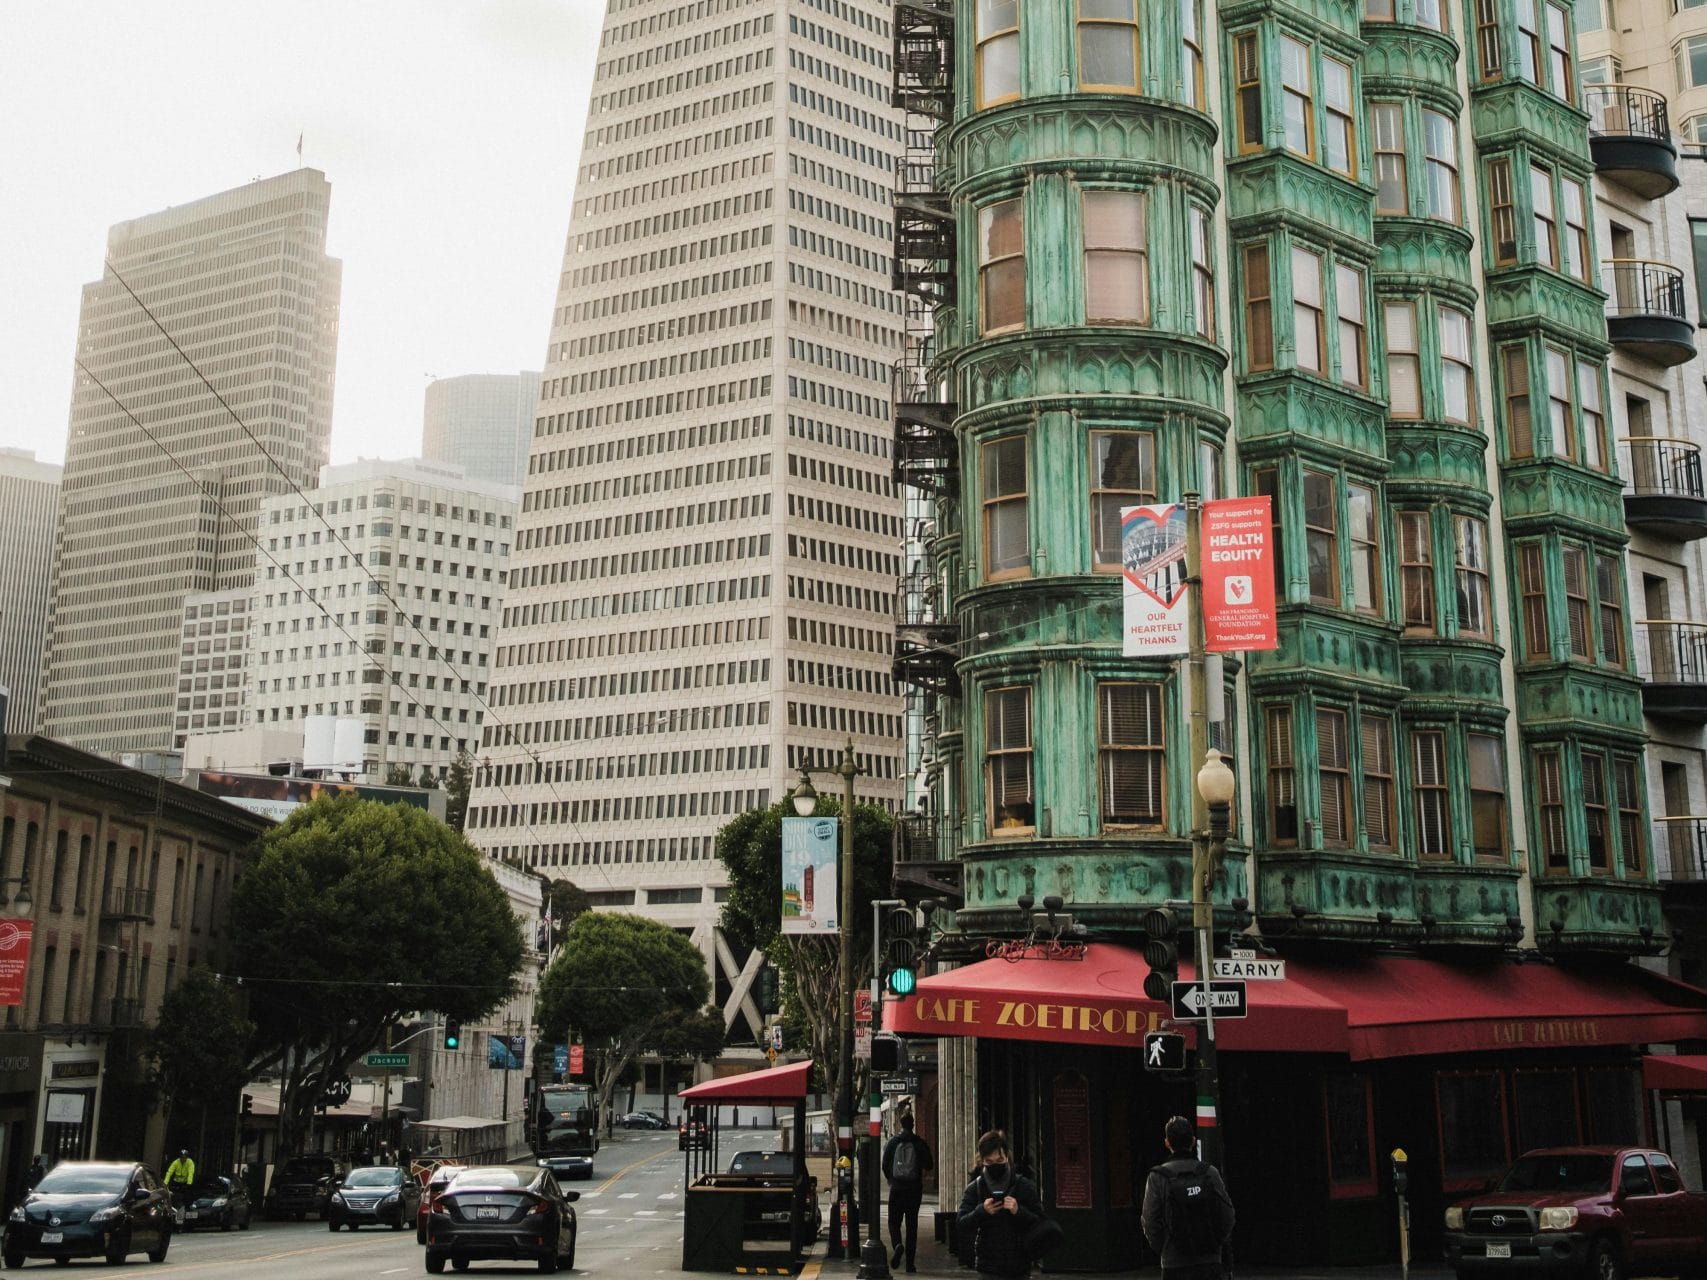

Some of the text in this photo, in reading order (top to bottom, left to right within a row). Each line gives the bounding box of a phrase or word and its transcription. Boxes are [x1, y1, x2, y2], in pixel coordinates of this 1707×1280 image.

[1226, 509, 1252, 518] support
[1231, 520, 1262, 528] supports
[1210, 533, 1263, 547] HEALTH
[1212, 548, 1263, 562] EQUITY
[1147, 612, 1166, 621] OUR
[1131, 622, 1183, 634] HEARTFELT
[1218, 620, 1262, 628] FOUNDATION
[1138, 635, 1177, 646] THANKS
[1215, 633, 1266, 642] ThankYouSF.org
[1218, 993, 1237, 1006] WAY
[916, 997, 1166, 1034] CAFE ZOETROPE
[371, 1057, 407, 1065] Jackson
[1187, 1186, 1201, 1196] ZIP
